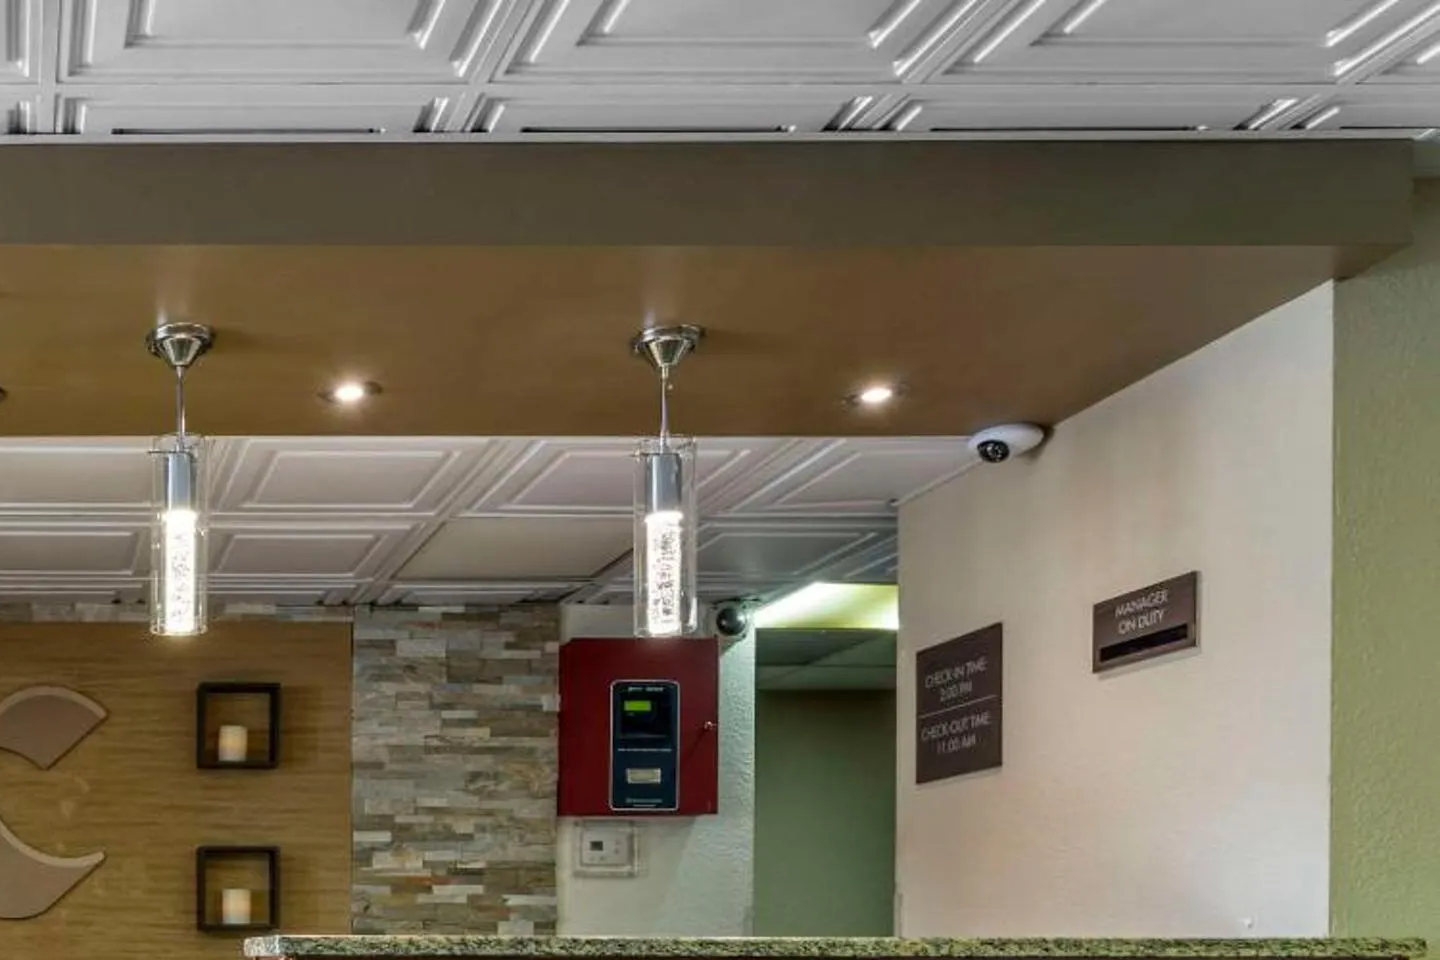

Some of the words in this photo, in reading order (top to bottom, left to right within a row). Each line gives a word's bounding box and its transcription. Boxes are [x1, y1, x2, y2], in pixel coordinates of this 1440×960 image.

[1115, 590, 1168, 617] MANAGER
[1118, 616, 1136, 634] ON
[1138, 609, 1164, 628] DUTY
